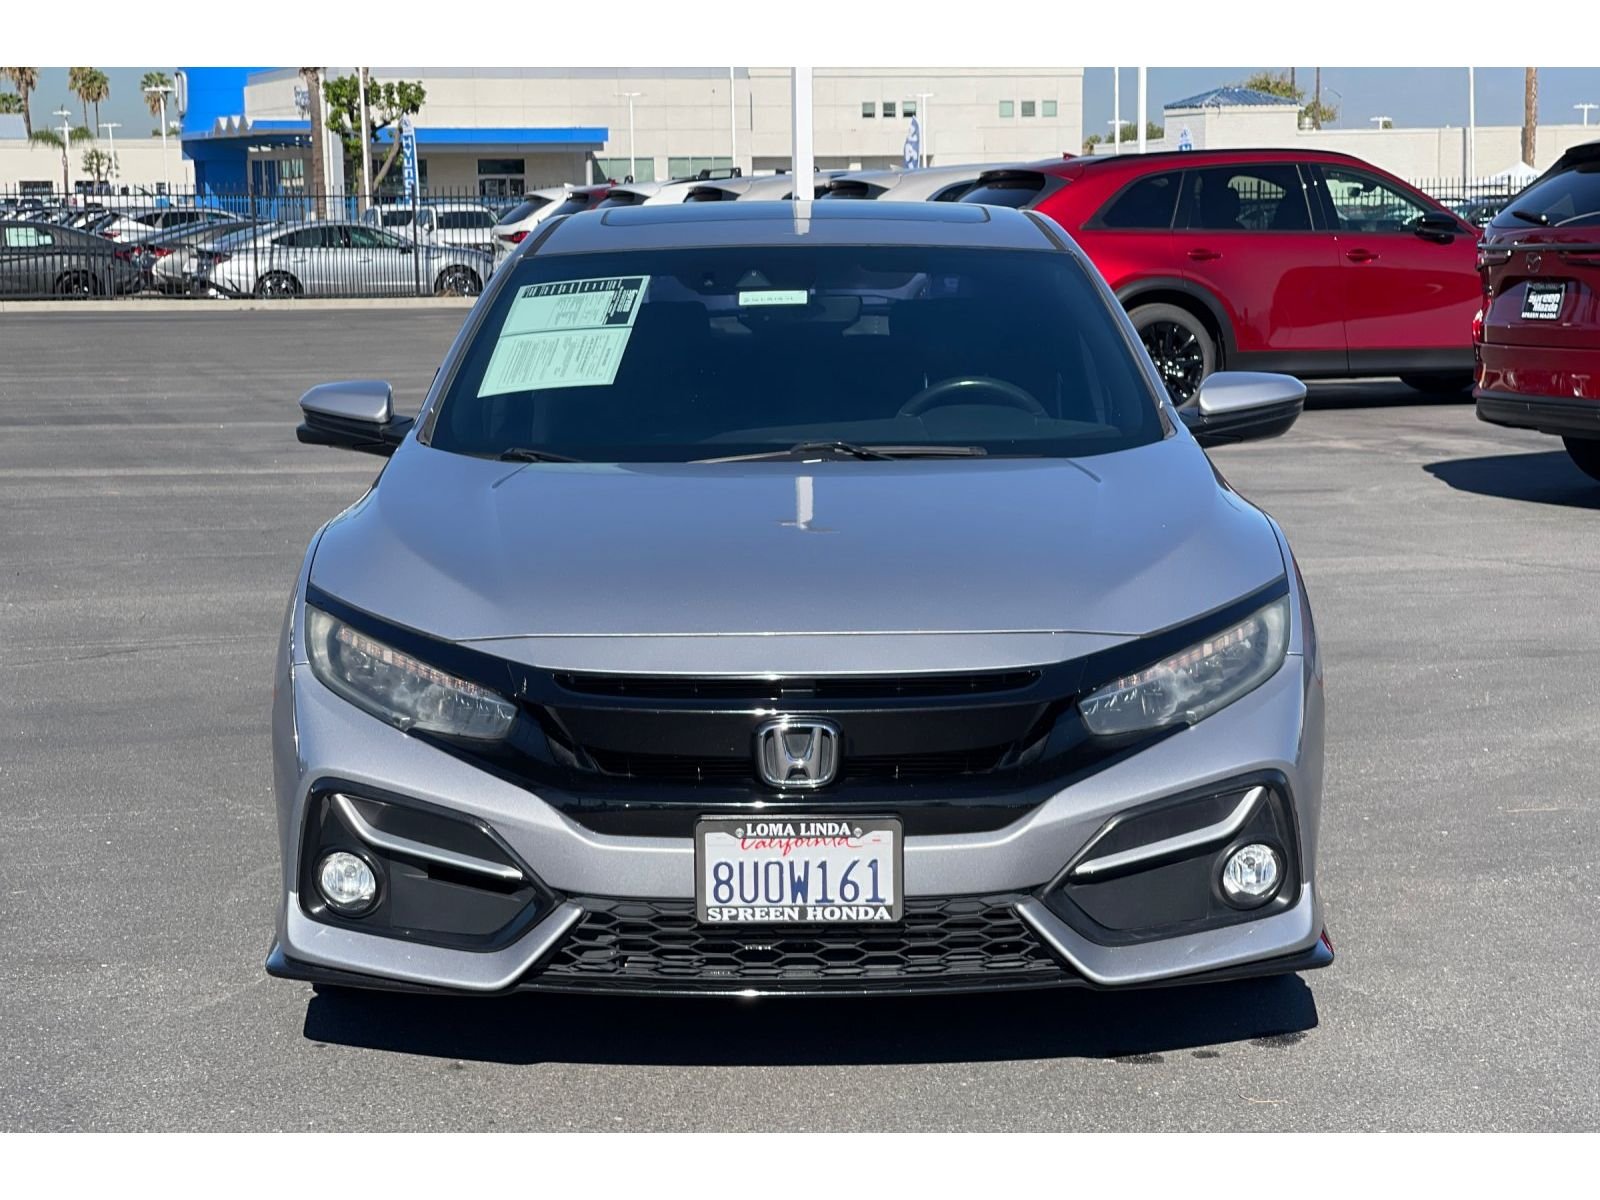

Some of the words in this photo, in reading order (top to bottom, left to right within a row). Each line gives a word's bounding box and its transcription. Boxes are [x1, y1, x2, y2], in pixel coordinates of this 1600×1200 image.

[746, 823, 796, 836] LOMA
[800, 822, 851, 836] LINDA
[707, 907, 799, 921] SPREEN
[806, 907, 892, 921] HONDA
